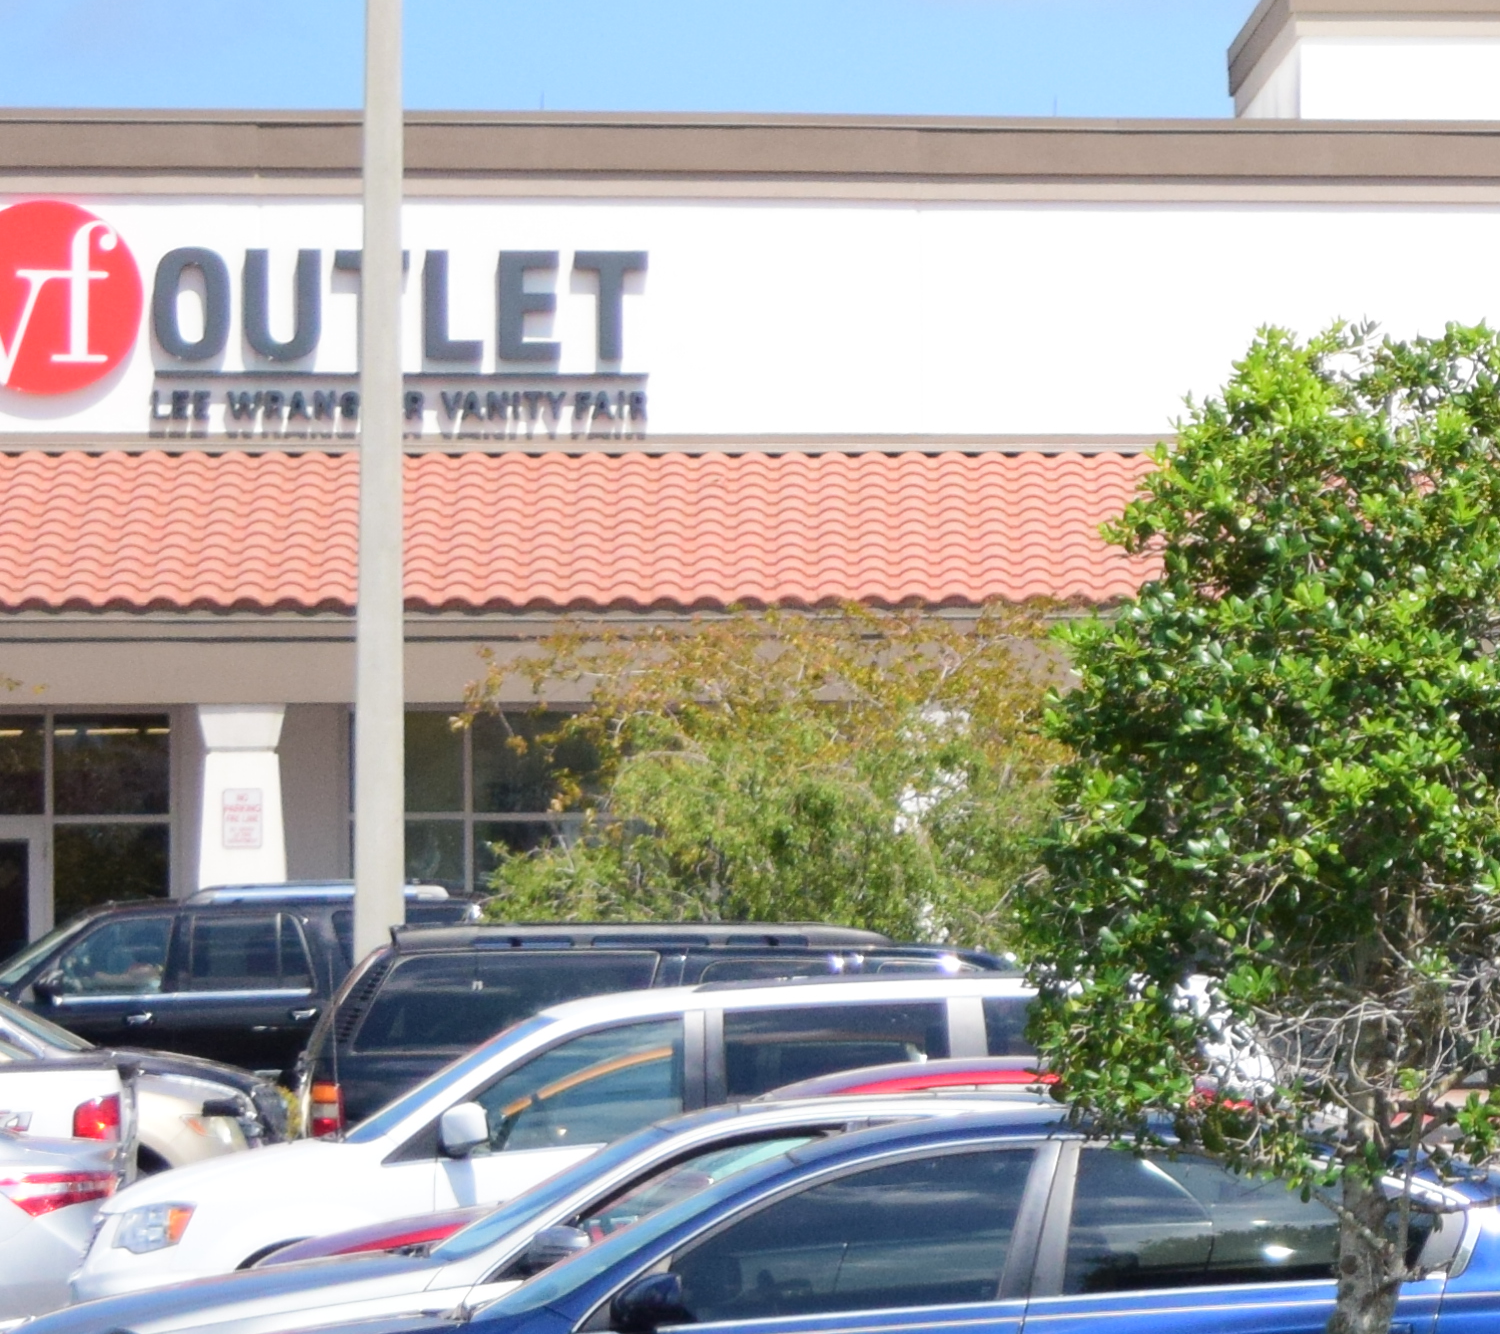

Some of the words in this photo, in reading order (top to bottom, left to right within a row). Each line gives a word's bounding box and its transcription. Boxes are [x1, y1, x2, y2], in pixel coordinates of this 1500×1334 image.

[152, 389, 211, 421] LEE
[227, 389, 426, 422] WRANGR
[441, 389, 567, 422] VANITY
[575, 390, 649, 422] FAIR
